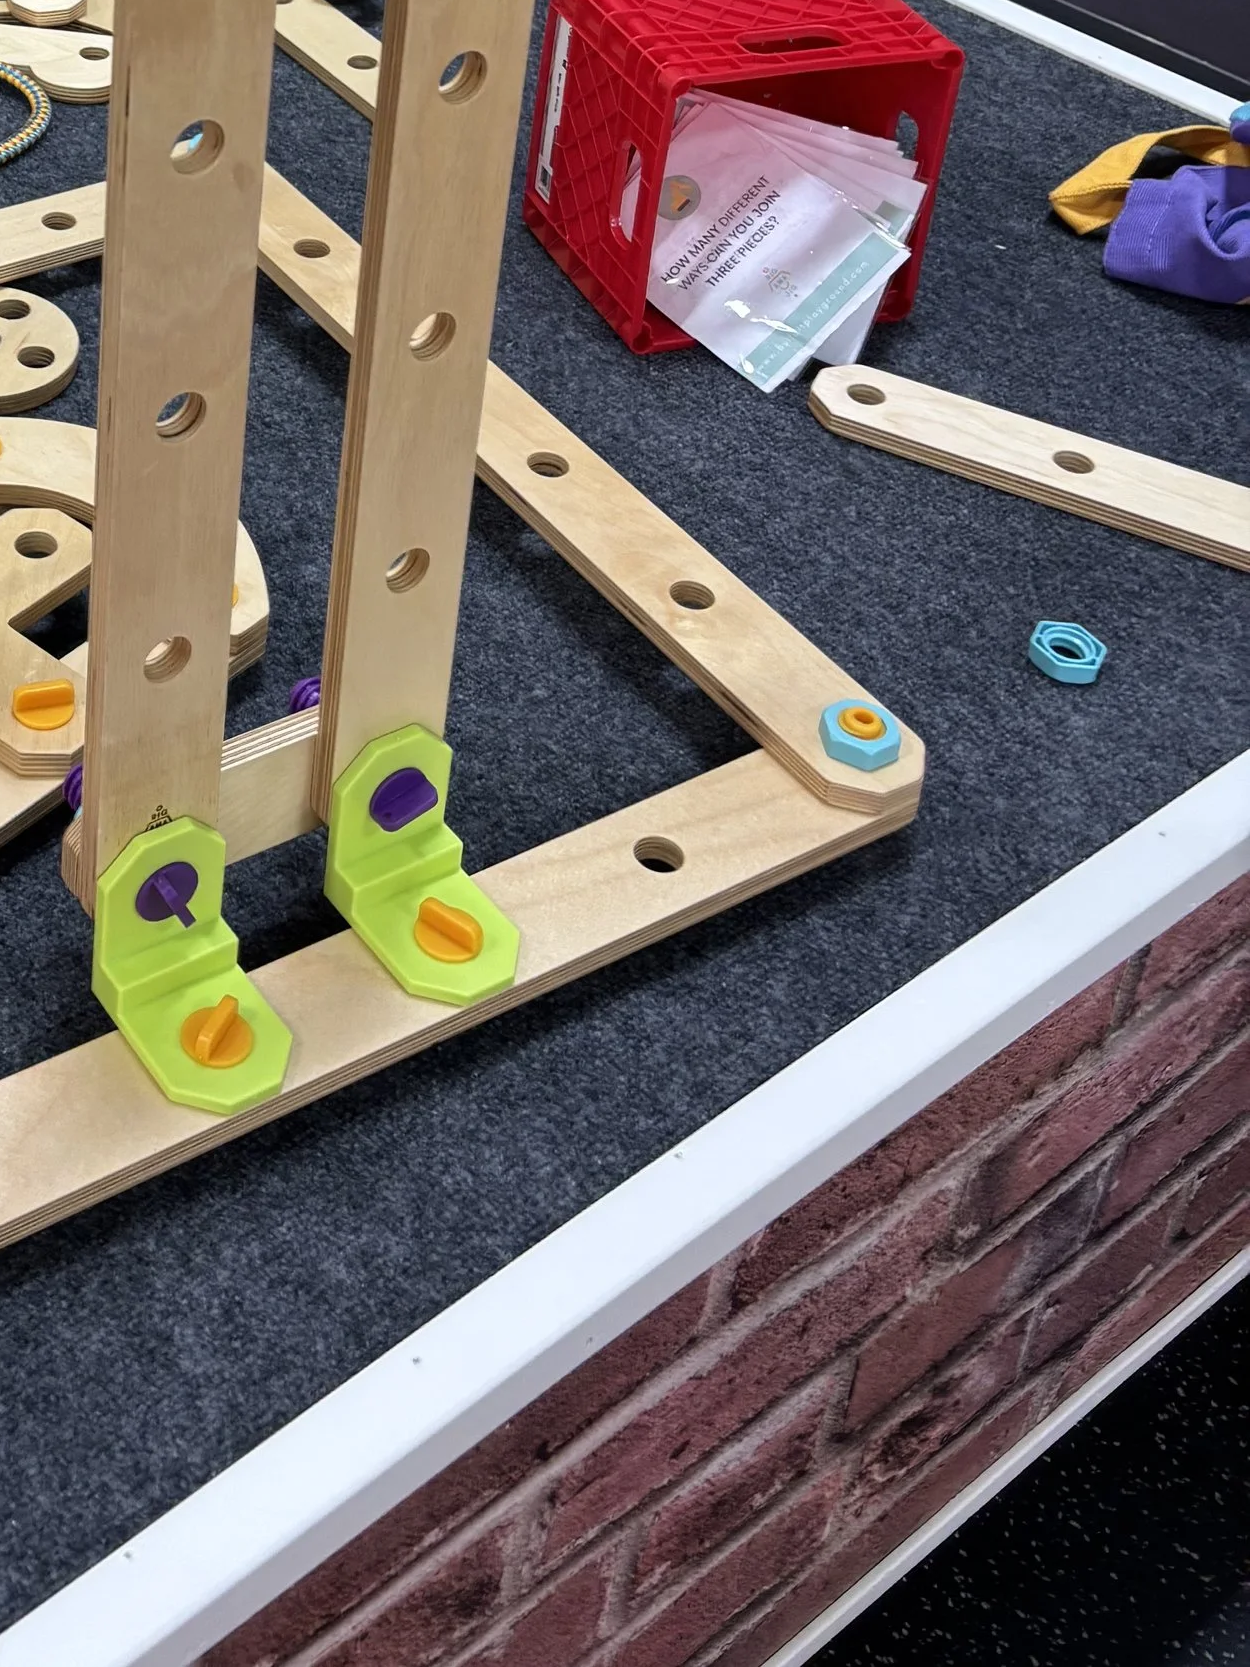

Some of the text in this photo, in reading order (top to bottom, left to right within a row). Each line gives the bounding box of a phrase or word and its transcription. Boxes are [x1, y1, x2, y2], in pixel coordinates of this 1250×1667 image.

[661, 175, 770, 283] HOW MANY DIFFERENT
[678, 190, 781, 290] WAYS CAN YOU JOIN
[705, 215, 780, 287] THREE PIECES?
